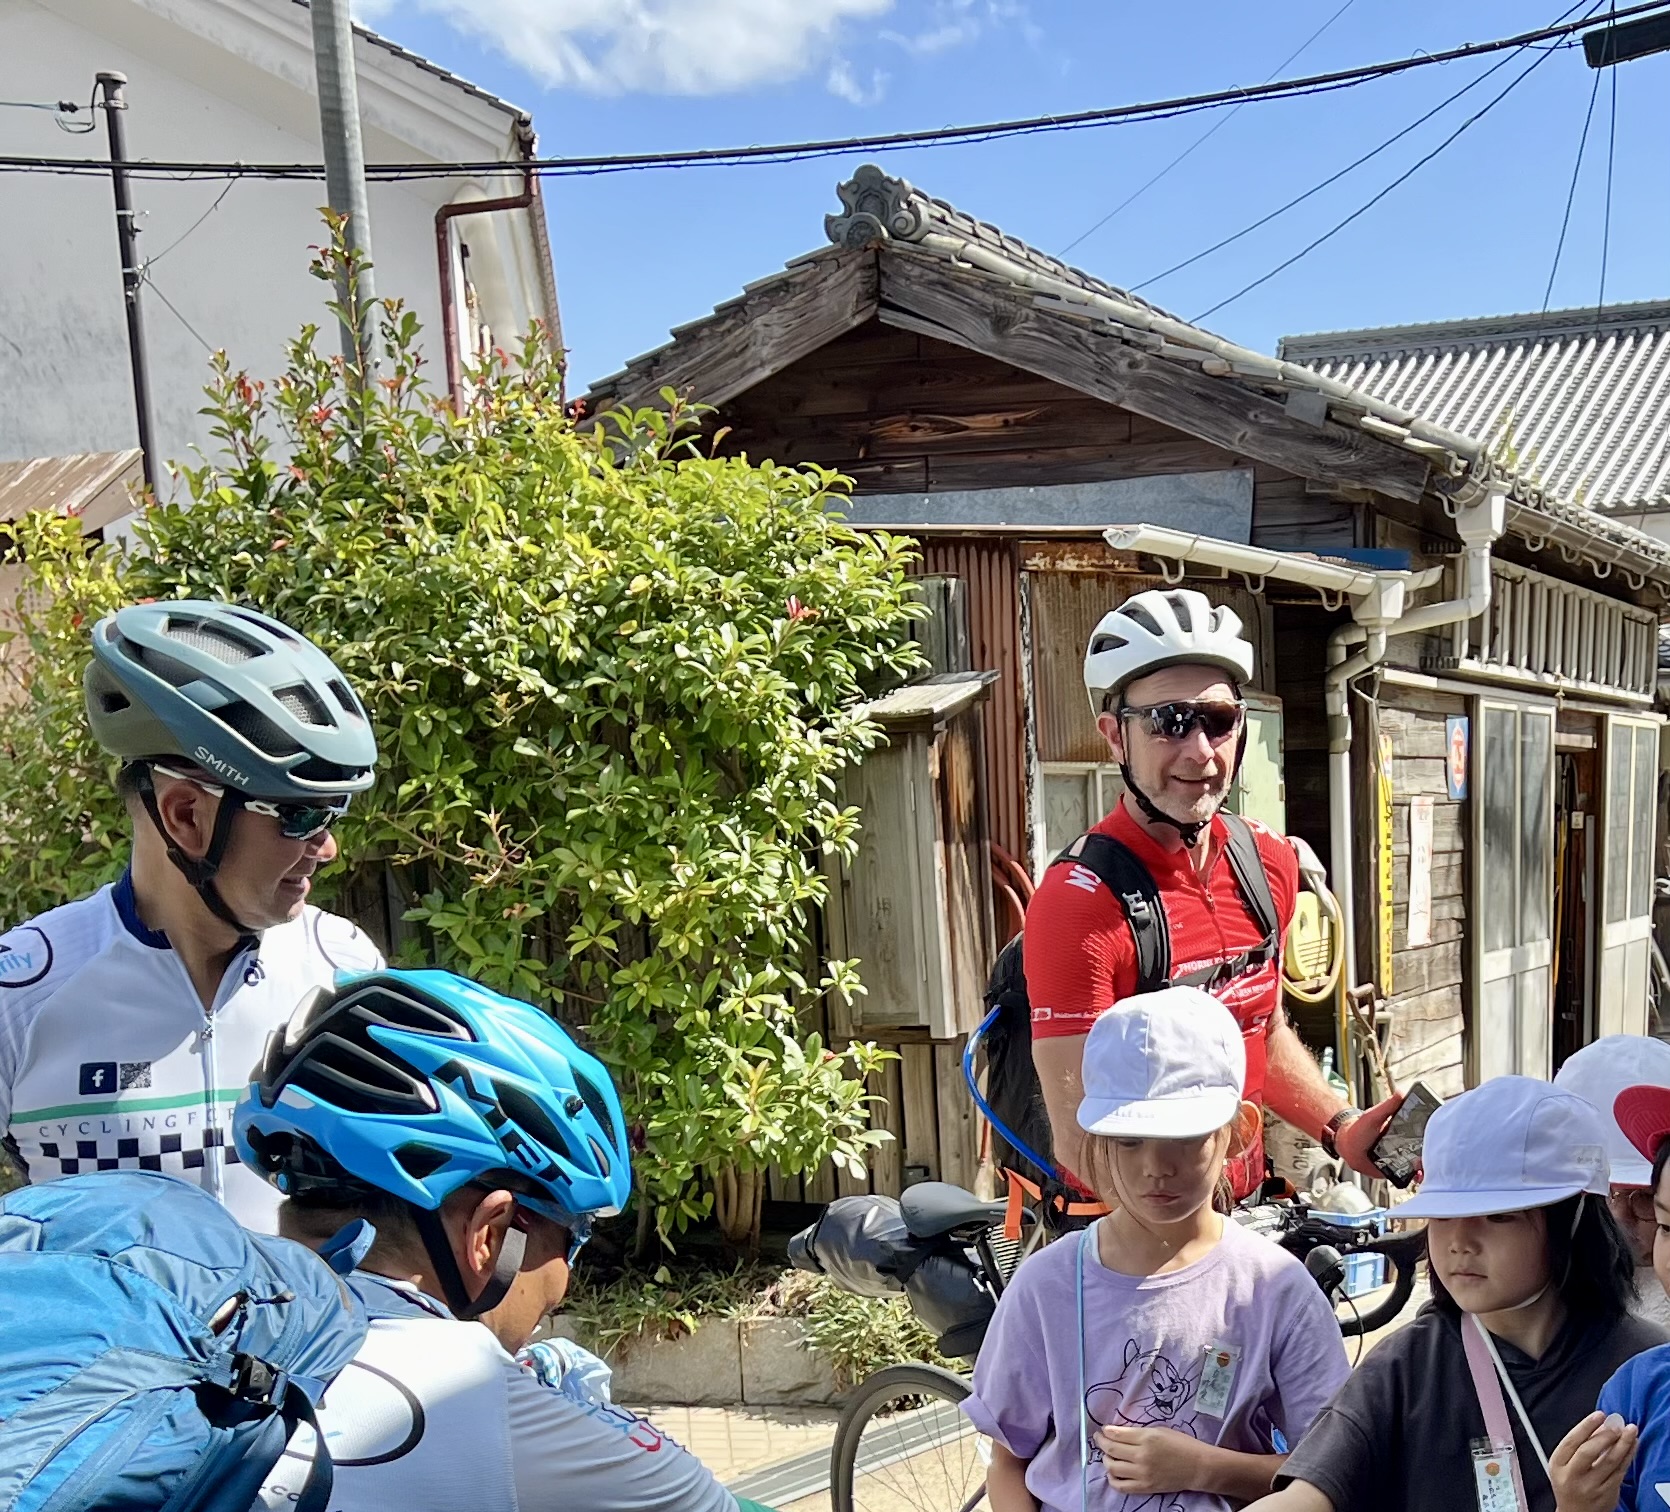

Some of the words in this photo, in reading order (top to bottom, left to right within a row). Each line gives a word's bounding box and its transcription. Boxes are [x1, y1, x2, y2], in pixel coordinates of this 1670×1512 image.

[194, 746, 250, 786] SMITH
[0, 952, 33, 978] rity
[432, 1058, 573, 1186] MET
